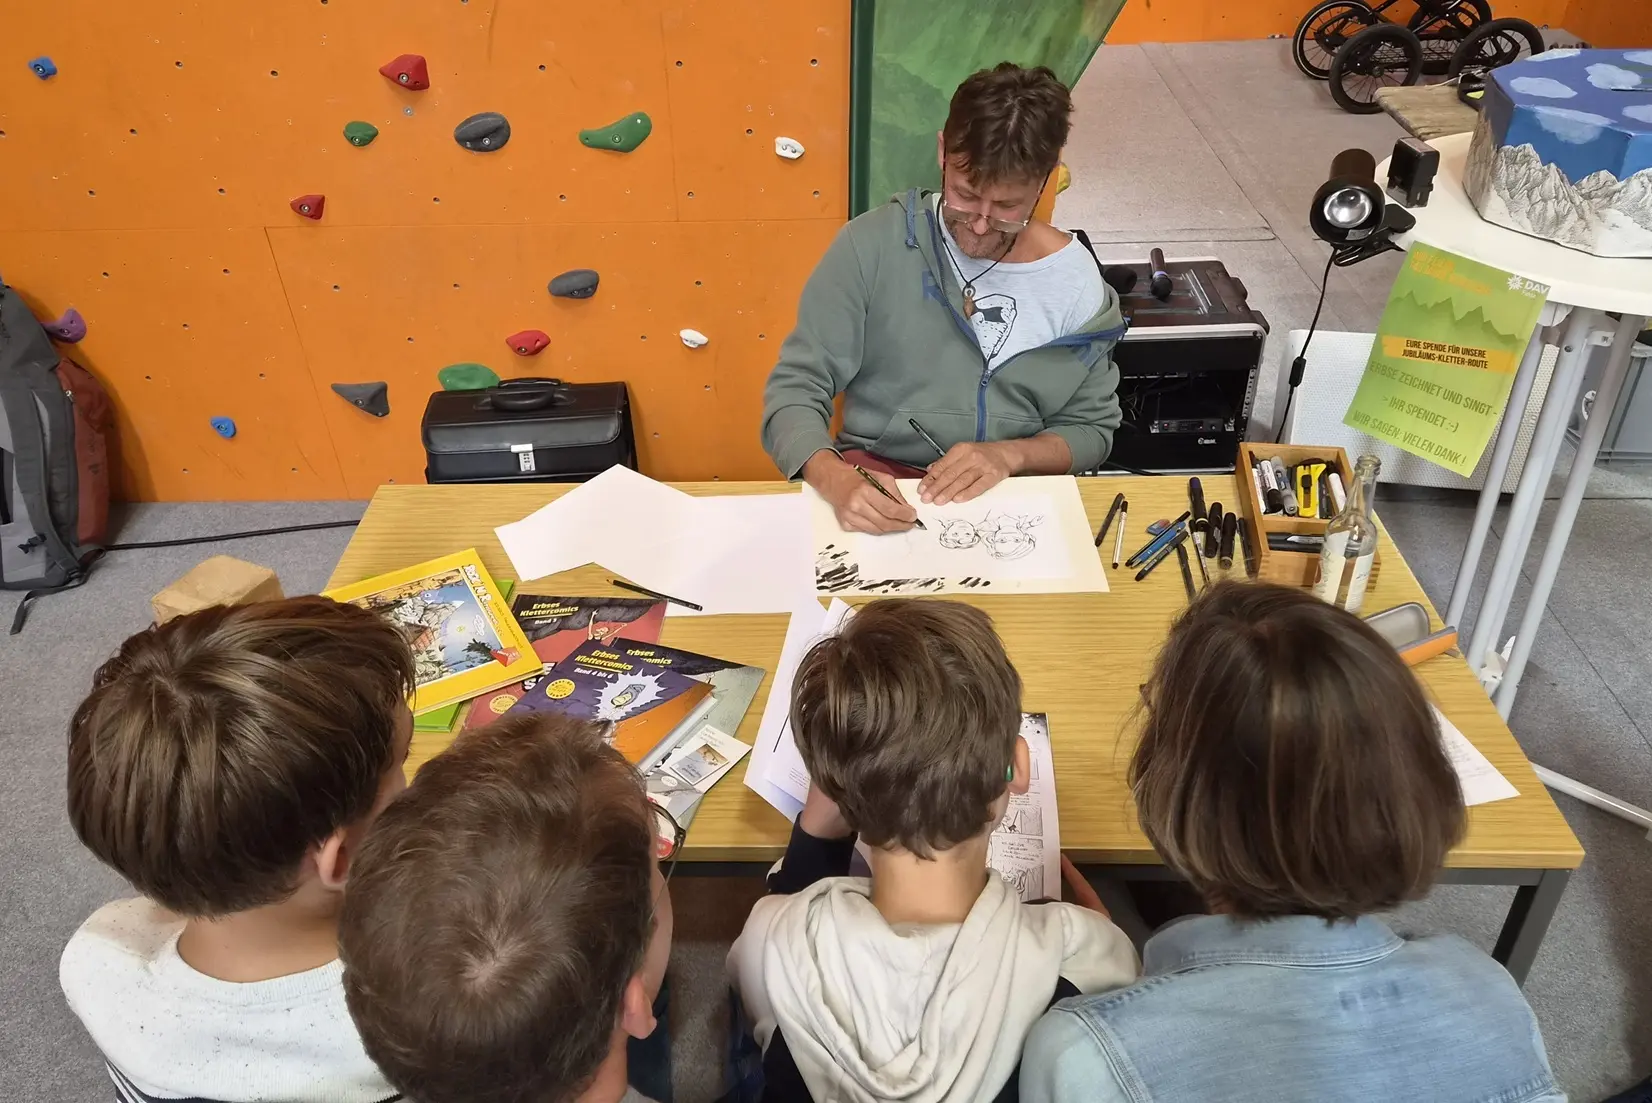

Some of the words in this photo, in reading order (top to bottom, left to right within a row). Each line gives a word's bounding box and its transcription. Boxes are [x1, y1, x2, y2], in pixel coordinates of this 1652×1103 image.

[1524, 279, 1550, 294] DAV
[1405, 339, 1421, 348] EURE
[1422, 341, 1446, 353] SPENDE
[1448, 344, 1461, 355] FÜR
[1461, 347, 1487, 359] UNSERE
[1402, 349, 1489, 369] JUBILÄUMS-KLETTER-ROUTE
[1369, 360, 1398, 380] ERBSE
[1399, 371, 1443, 397] ZEICHNET
[1442, 387, 1463, 405] UND
[1463, 396, 1493, 417] SINGT
[1388, 397, 1406, 412] IHR
[1406, 403, 1447, 429] SPENDET
[1352, 411, 1371, 425] WIR
[1402, 431, 1434, 454] VIELEN
[1434, 444, 1463, 465] DANK
[519, 605, 580, 618] Klettercomics
[532, 601, 561, 610] Erbses
[591, 649, 621, 660] Erbses
[626, 649, 656, 657] Erbses
[574, 654, 634, 671] Klettercomics
[573, 667, 592, 676] Band
